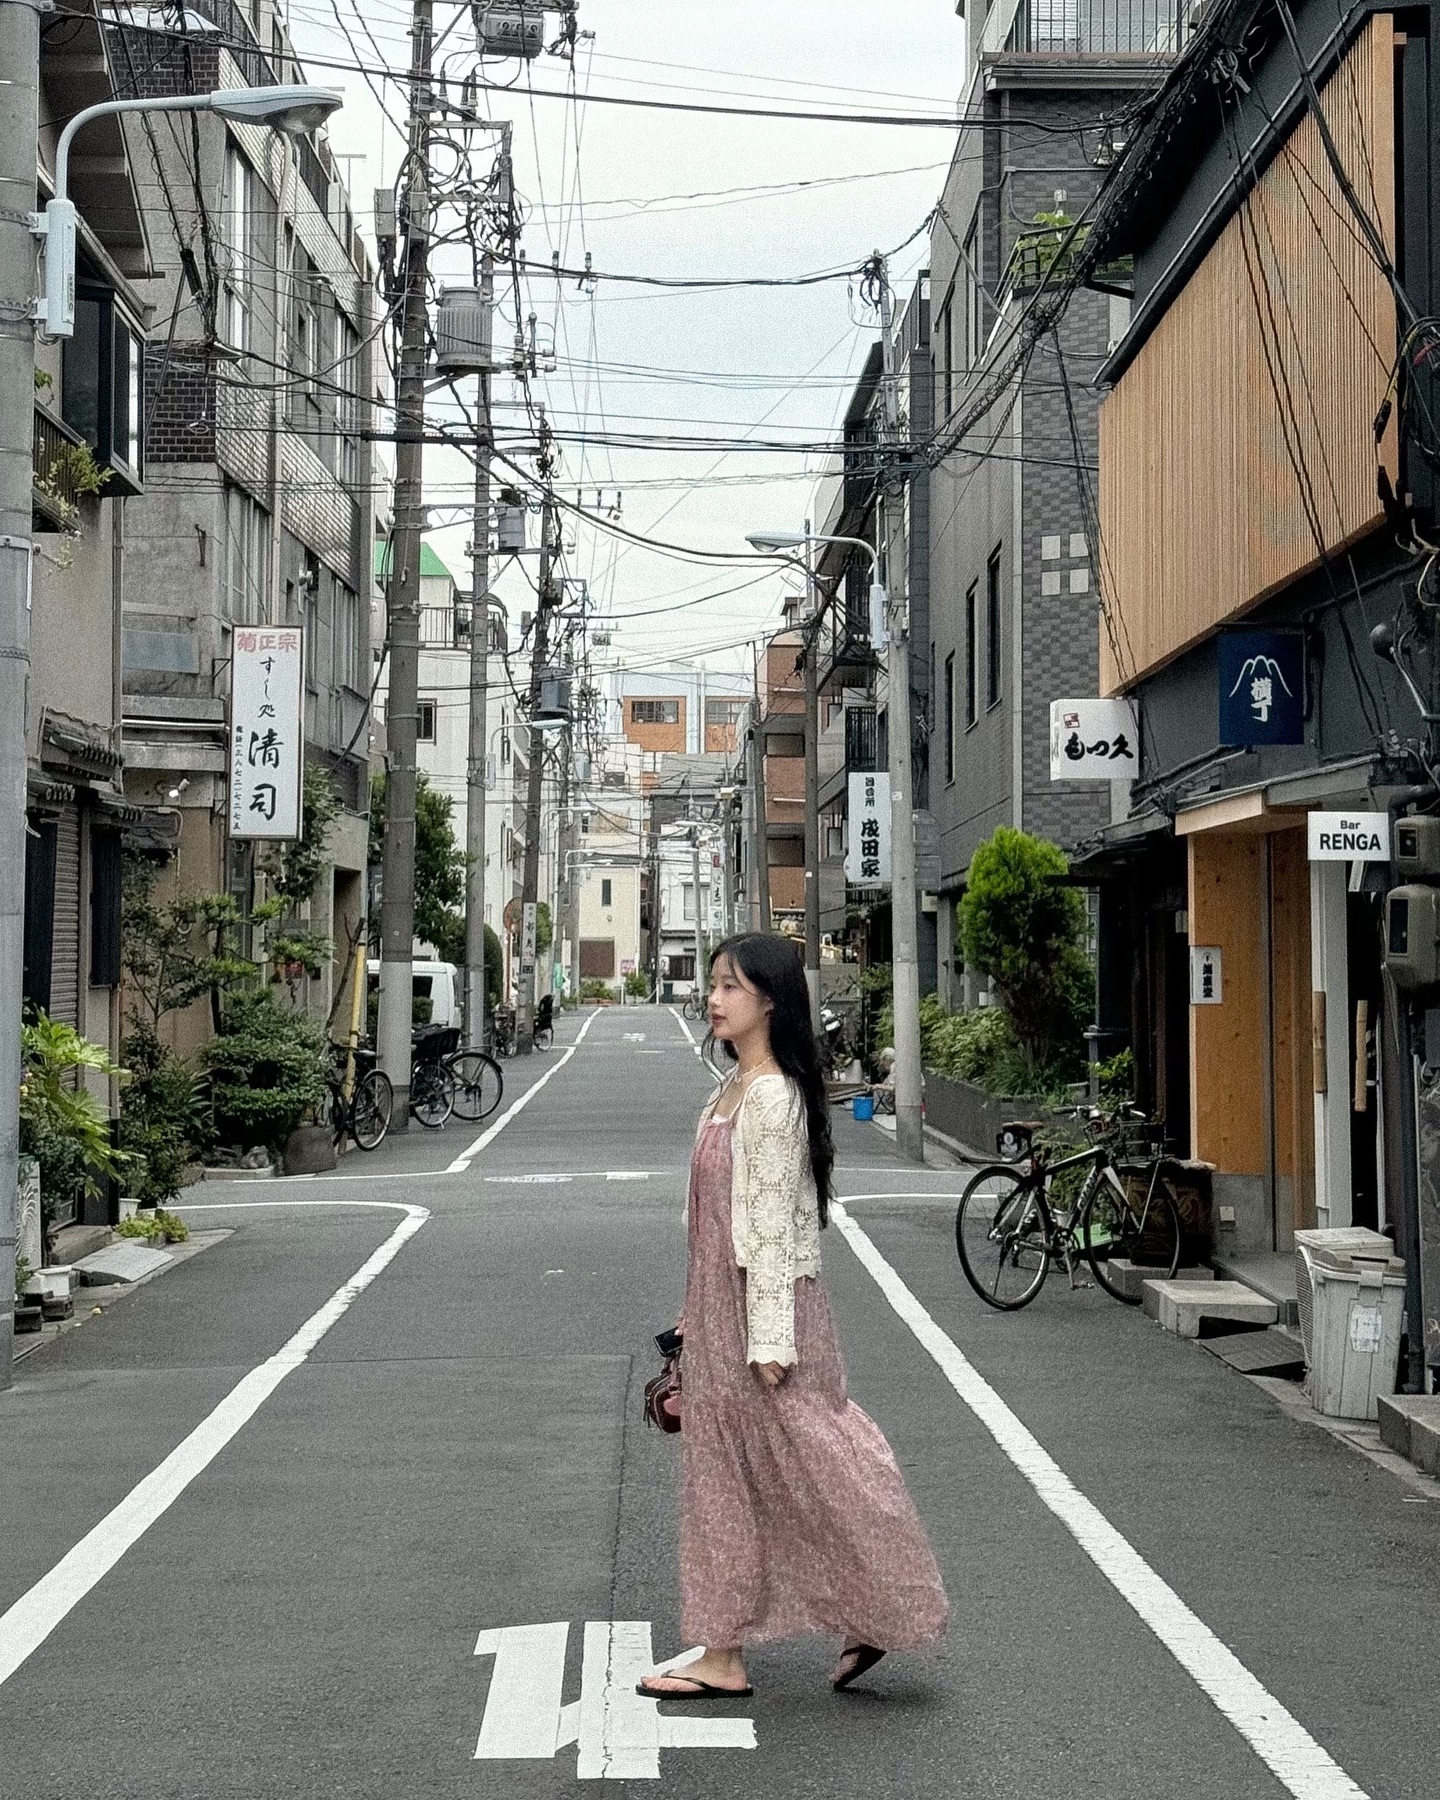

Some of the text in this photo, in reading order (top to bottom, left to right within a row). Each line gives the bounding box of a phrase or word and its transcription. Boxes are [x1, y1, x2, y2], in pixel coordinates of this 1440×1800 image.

[236, 633, 298, 653] 菊正宗
[248, 656, 285, 822] すし処 清司
[1063, 731, 1135, 762] もつ久
[1340, 819, 1361, 831] Bar
[860, 817, 881, 878] 成田家
[1319, 832, 1383, 851] RENGA
